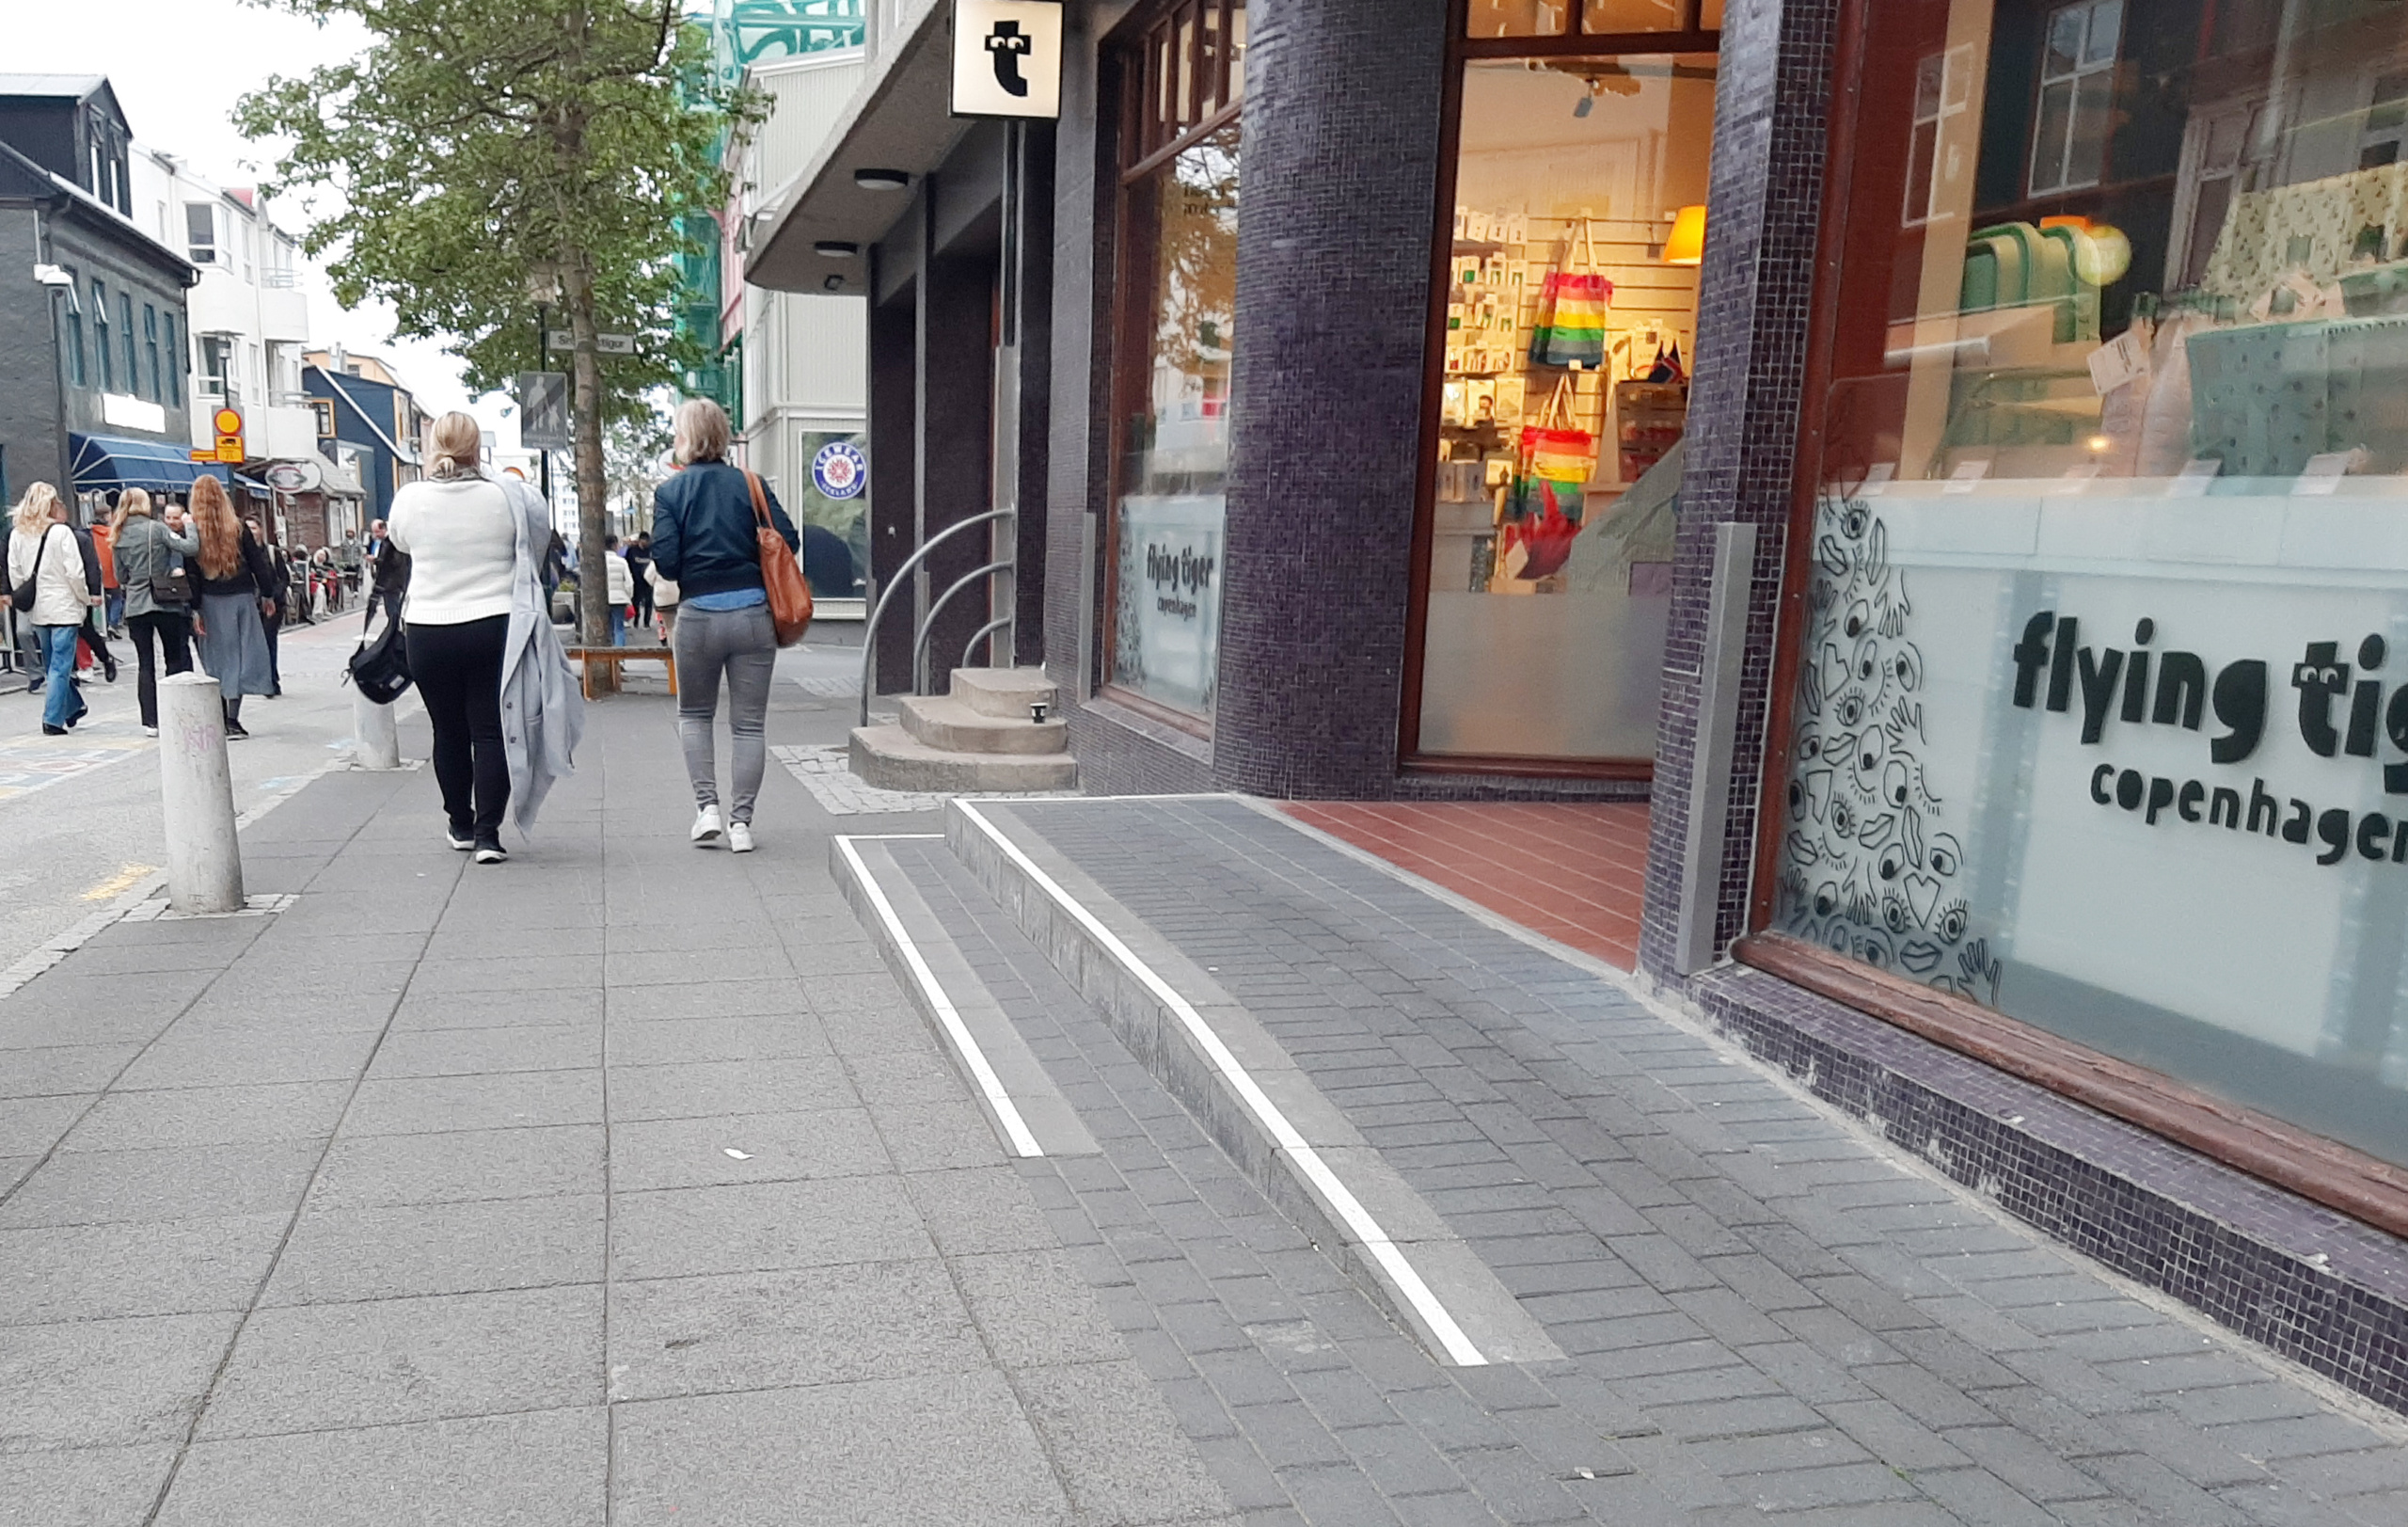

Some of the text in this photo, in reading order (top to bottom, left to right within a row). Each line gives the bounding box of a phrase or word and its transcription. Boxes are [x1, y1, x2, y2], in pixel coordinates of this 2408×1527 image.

[814, 444, 864, 470] ICEWEAR
[1147, 543, 1214, 596] flying tiger
[1157, 595, 1197, 622] copenhagen
[2012, 610, 2269, 765] flying
